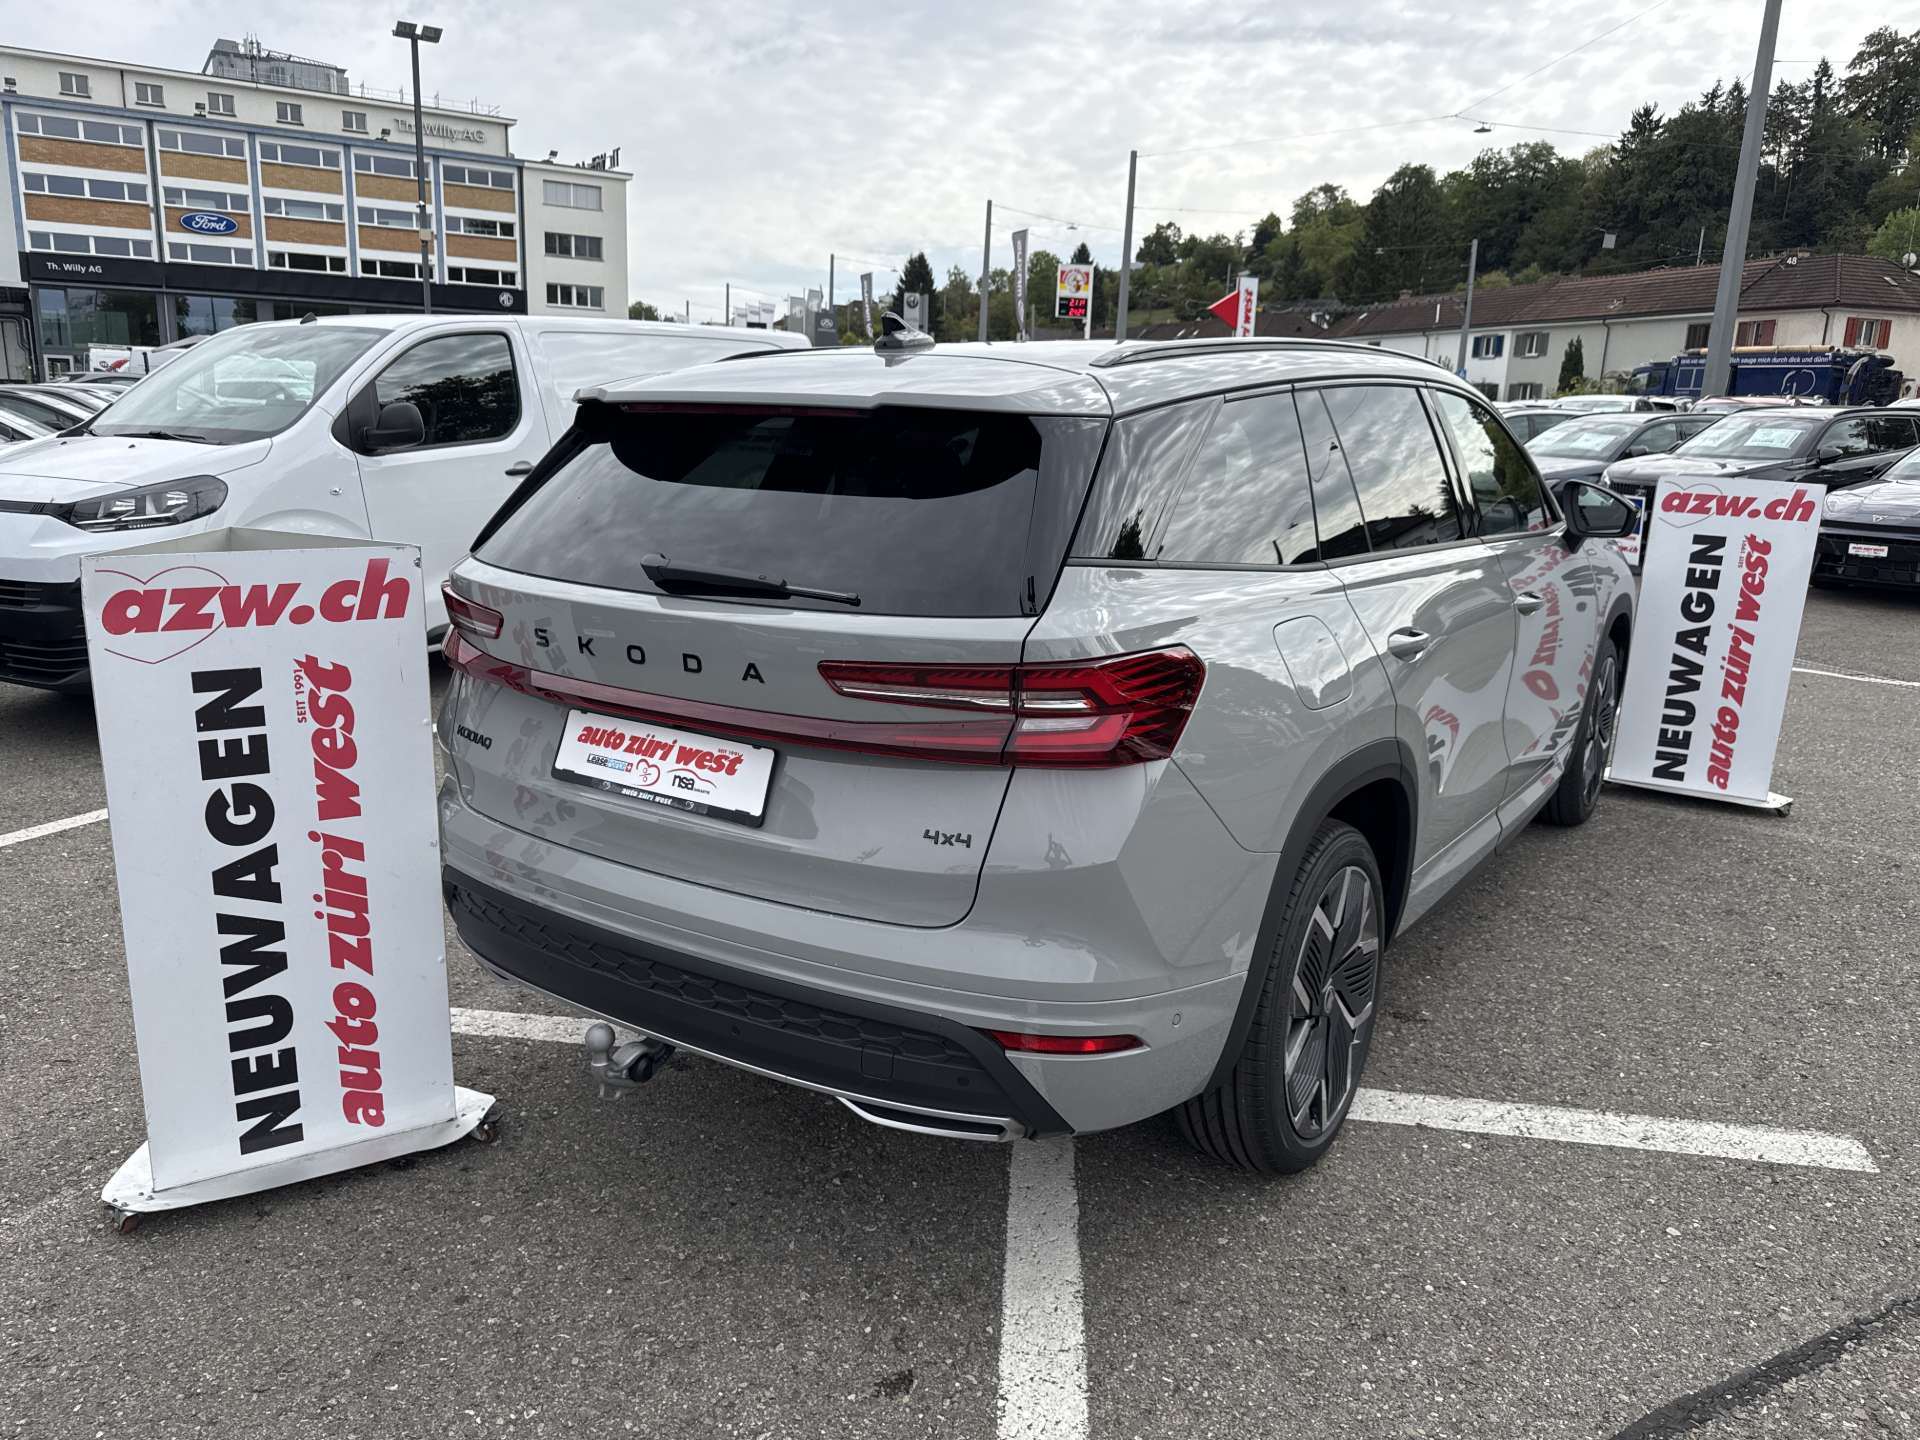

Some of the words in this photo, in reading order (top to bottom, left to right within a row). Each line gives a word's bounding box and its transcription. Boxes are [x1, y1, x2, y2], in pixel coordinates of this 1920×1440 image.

[422, 119, 458, 142] Willy
[463, 127, 485, 142] AG
[191, 214, 227, 232] Ford
[46, 261, 61, 271] Th.
[63, 263, 86, 274] Willy
[89, 265, 103, 273] AG
[1786, 256, 1798, 265] 48
[1660, 489, 1816, 522] azw.ch
[1735, 533, 1773, 622] west
[101, 558, 410, 636] azw.ch
[1652, 534, 1728, 782] NEUWAGEN
[1720, 623, 1756, 707] züri
[292, 668, 305, 696] 1991
[295, 699, 308, 724] SEIT
[294, 654, 362, 821] west
[456, 724, 493, 750] KODIAQ
[577, 725, 625, 750] auto
[624, 733, 678, 762] züri
[675, 745, 744, 776] west
[1706, 706, 1740, 790] auto
[621, 787, 638, 797] auto
[638, 790, 654, 801] züri
[654, 794, 673, 805] west
[672, 774, 695, 791] nsa
[923, 829, 972, 848] 4x4
[191, 667, 304, 1156] NEUWAGEN
[308, 830, 374, 976] züri
[325, 982, 385, 1128] auto
